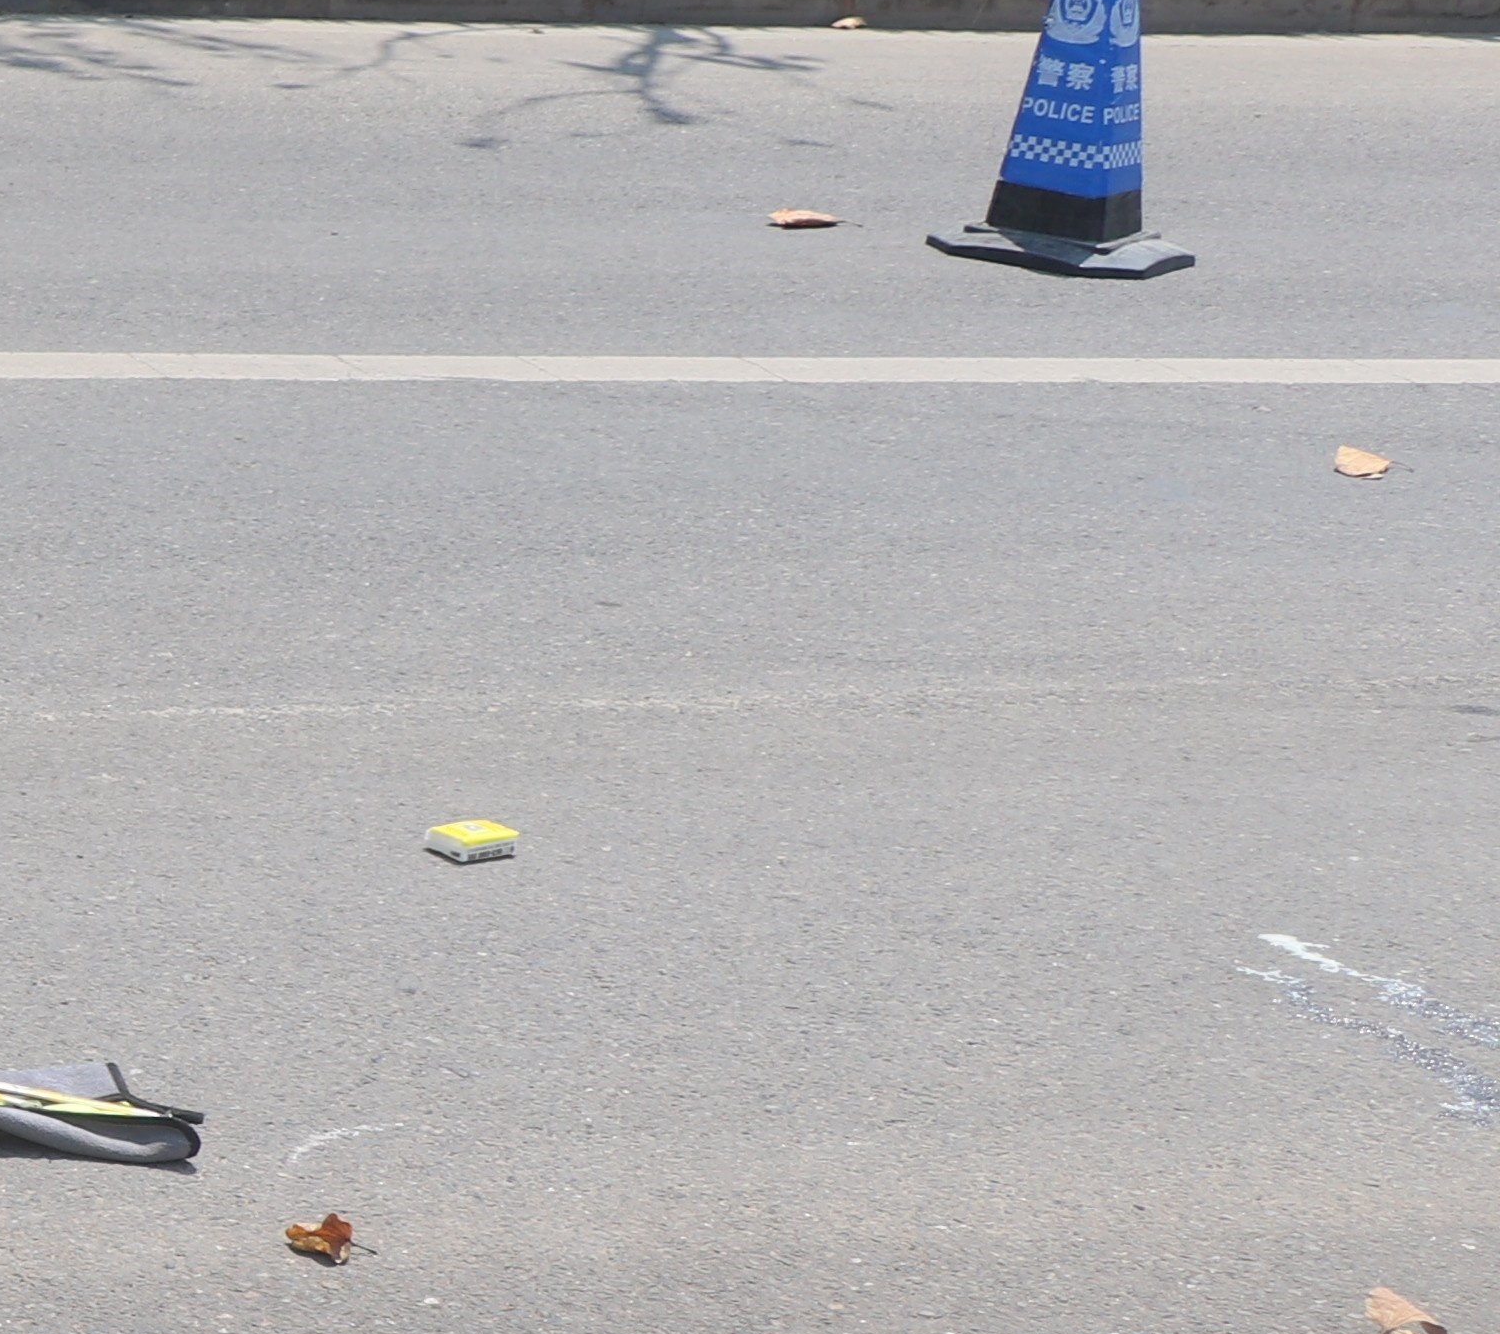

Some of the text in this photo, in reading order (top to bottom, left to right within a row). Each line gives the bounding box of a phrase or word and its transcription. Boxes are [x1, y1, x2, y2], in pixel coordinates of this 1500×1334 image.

[1036, 54, 1095, 91] 警察
[1110, 63, 1139, 94] 警察
[1022, 96, 1096, 124] POLICE
[1103, 103, 1140, 125] POLICE
